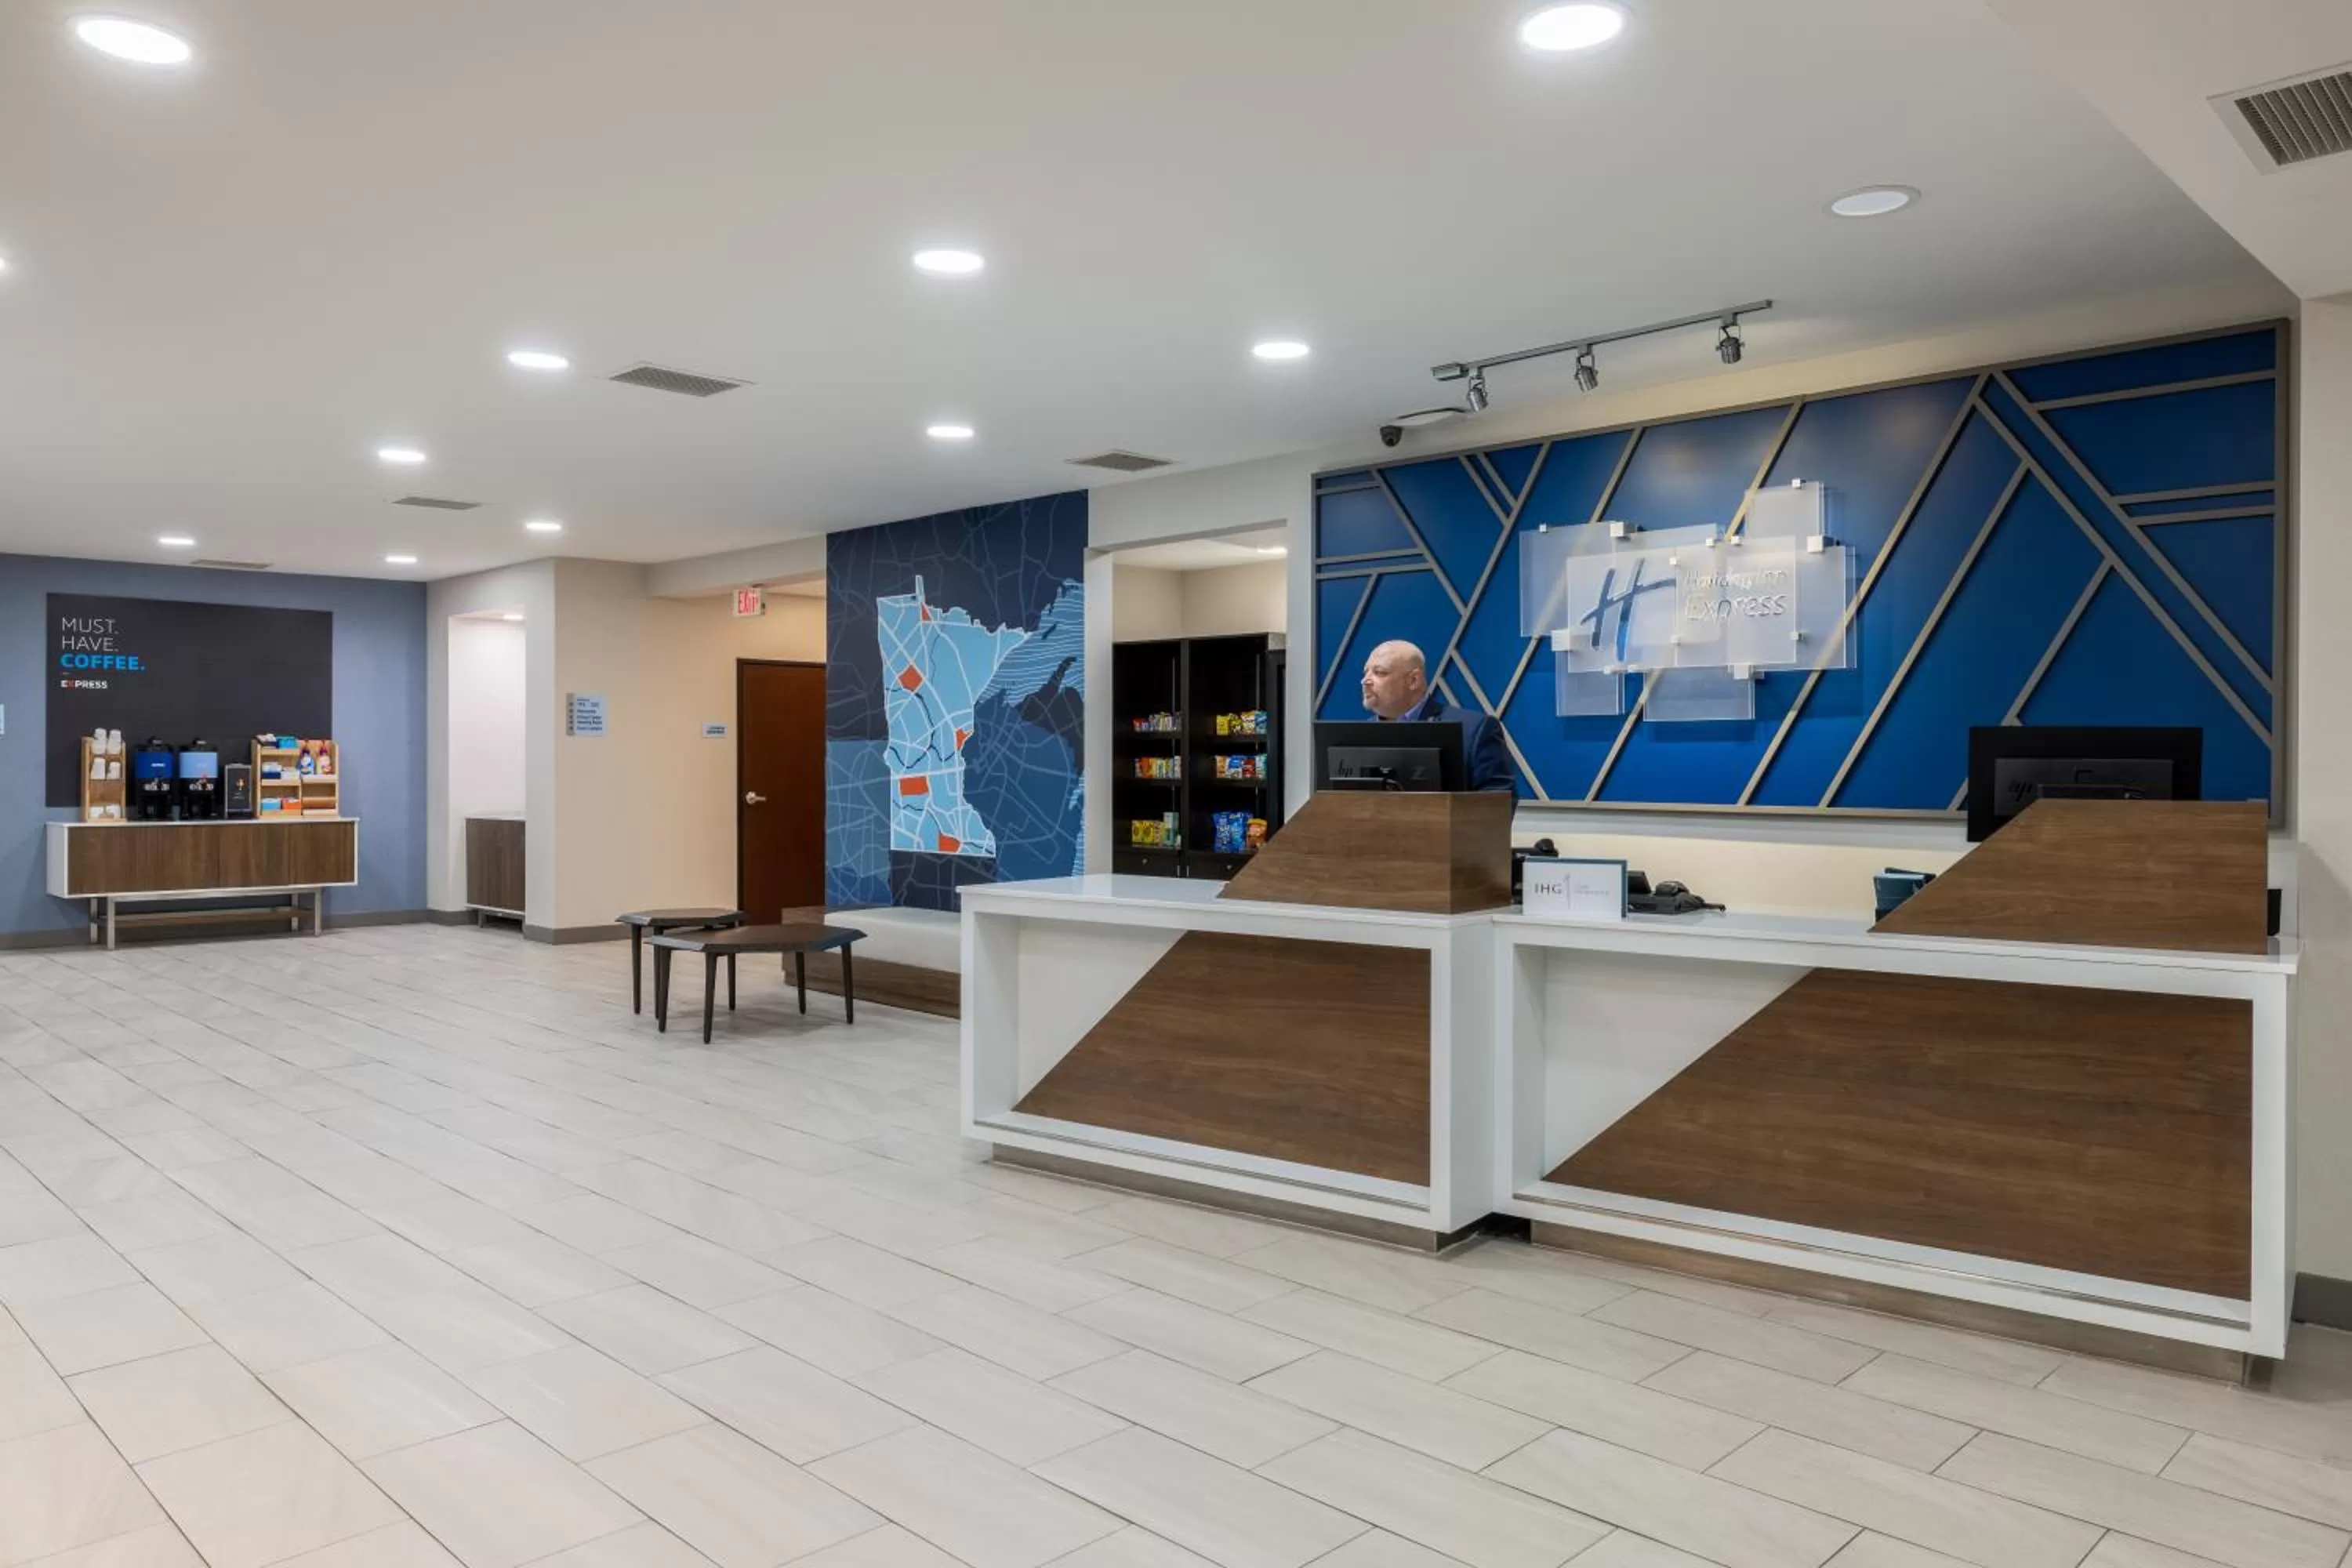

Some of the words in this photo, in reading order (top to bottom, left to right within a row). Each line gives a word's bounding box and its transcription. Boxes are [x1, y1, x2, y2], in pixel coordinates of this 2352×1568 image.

[738, 590, 759, 614] EXIT
[1685, 593, 1788, 625] Express
[62, 617, 119, 634] MUST.
[62, 635, 119, 652] HAVE.
[61, 653, 145, 670] COFFEE.
[1534, 882, 1562, 895] IHG
